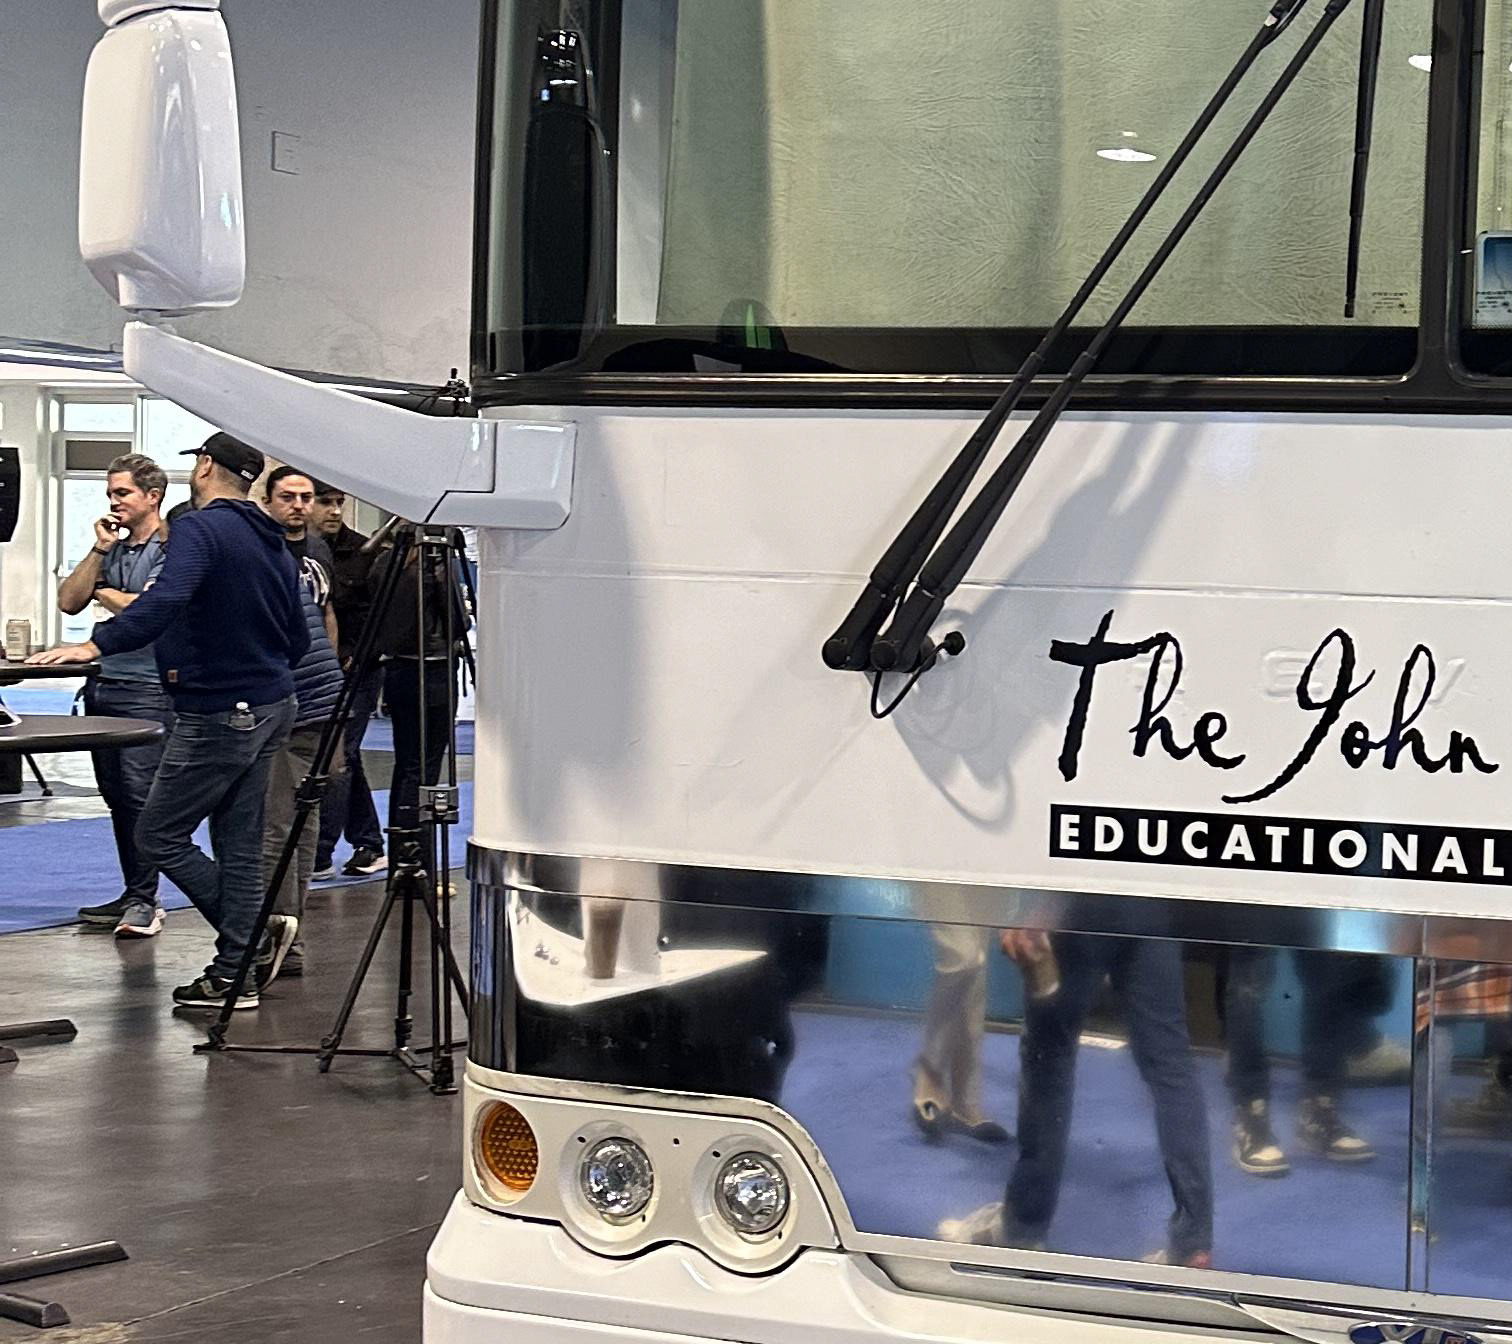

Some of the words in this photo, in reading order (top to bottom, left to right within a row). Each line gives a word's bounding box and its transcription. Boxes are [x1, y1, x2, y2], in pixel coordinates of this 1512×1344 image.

[1049, 609, 1246, 783] The
[1222, 628, 1500, 805] John
[1059, 813, 1505, 877] EDUCATIONAL
